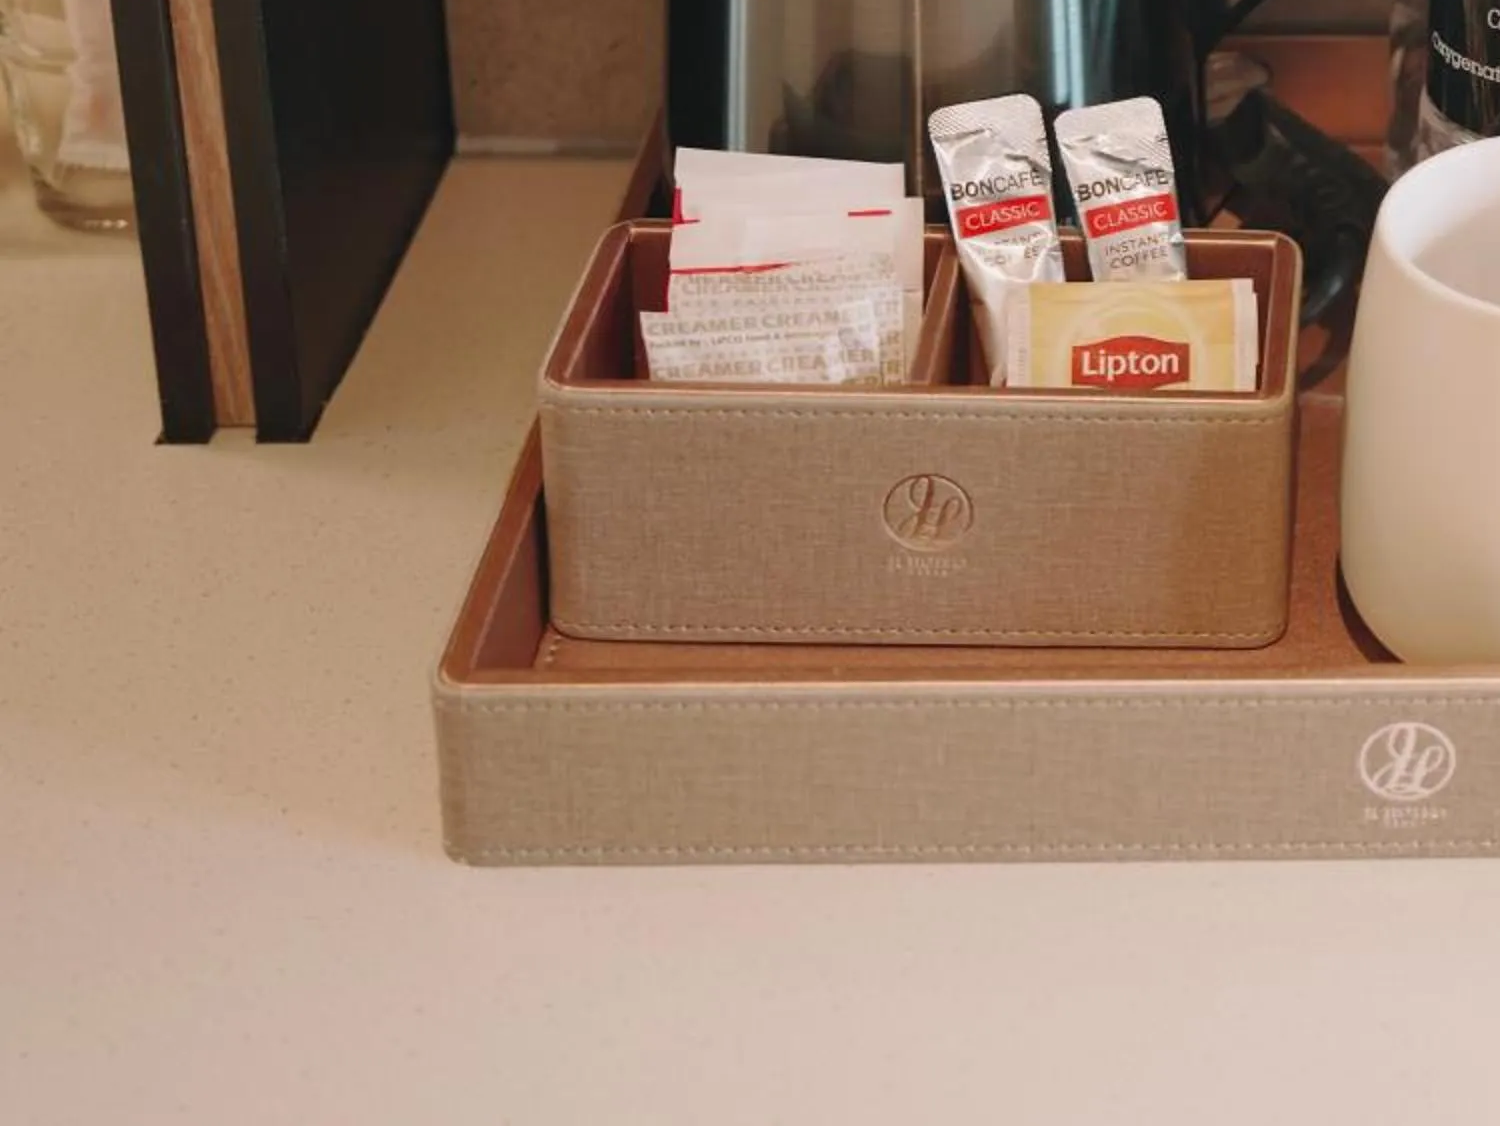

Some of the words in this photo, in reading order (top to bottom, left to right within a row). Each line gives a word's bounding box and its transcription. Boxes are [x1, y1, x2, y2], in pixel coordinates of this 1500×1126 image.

[965, 201, 1042, 231] CLASSIC
[1092, 201, 1169, 231] CLASSIC
[1110, 246, 1169, 269] COFFEE
[647, 314, 758, 336] CREAMER
[1082, 349, 1180, 381] Lipton
